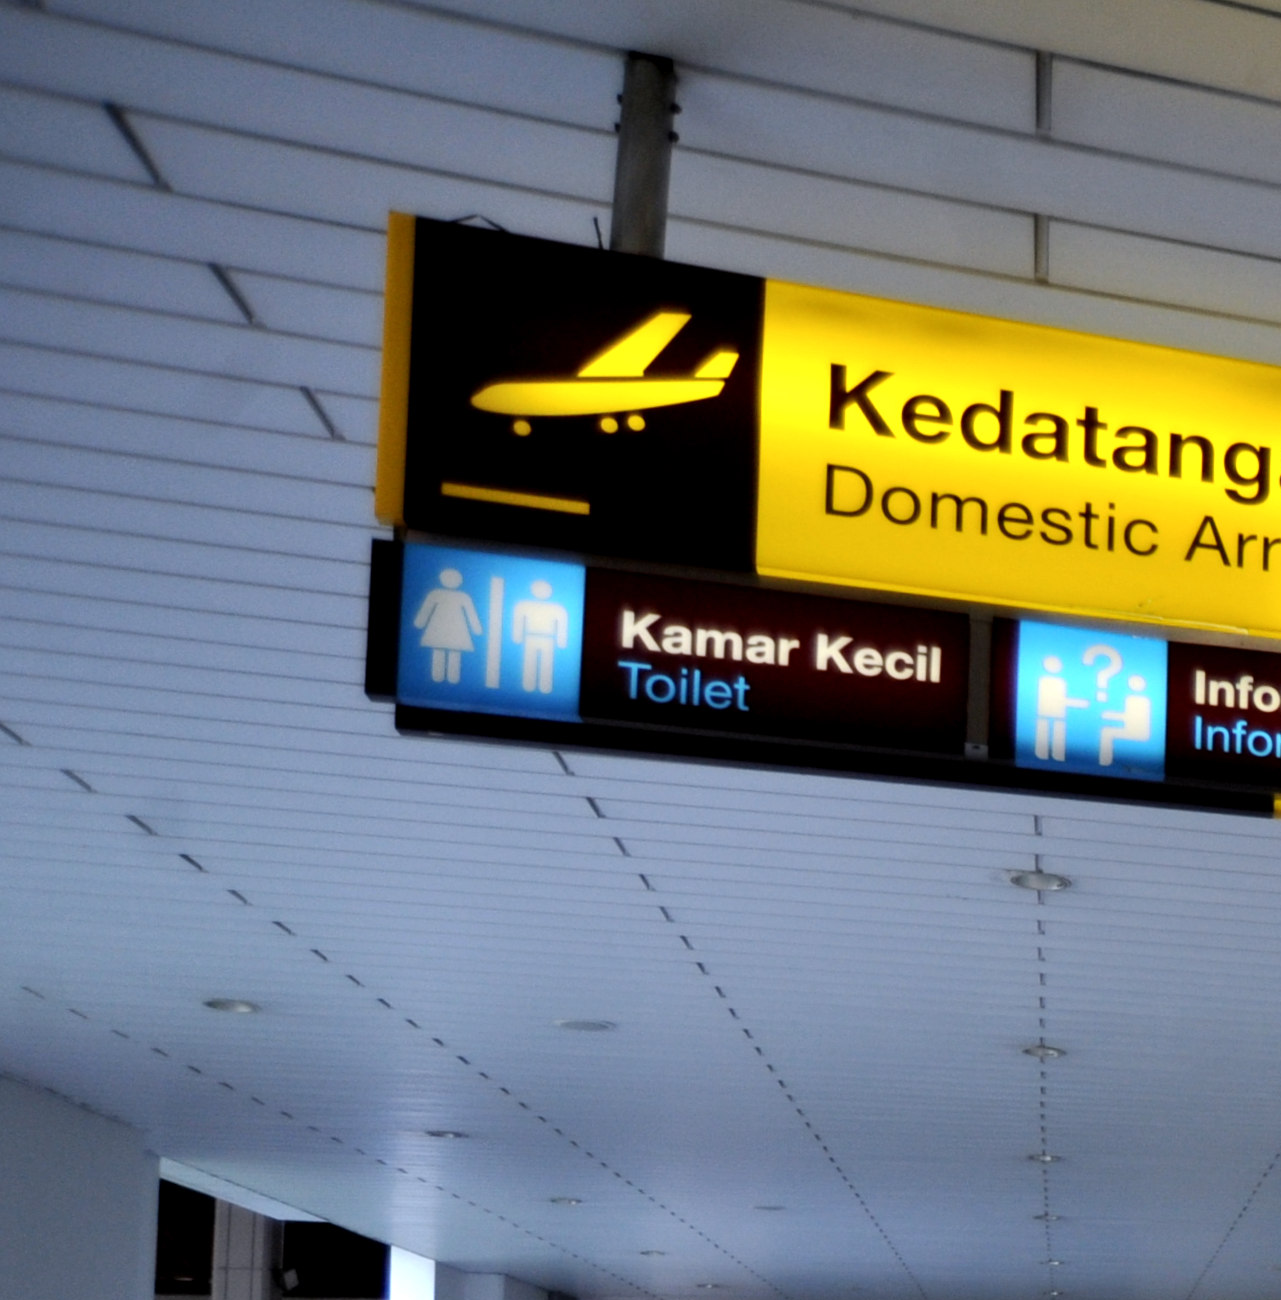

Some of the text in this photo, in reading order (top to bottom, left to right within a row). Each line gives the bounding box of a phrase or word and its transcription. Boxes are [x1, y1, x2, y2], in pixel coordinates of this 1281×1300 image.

[824, 464, 1160, 557] Domestic
[619, 611, 942, 684] Kamar Kecil
[619, 661, 752, 712] Toilet
